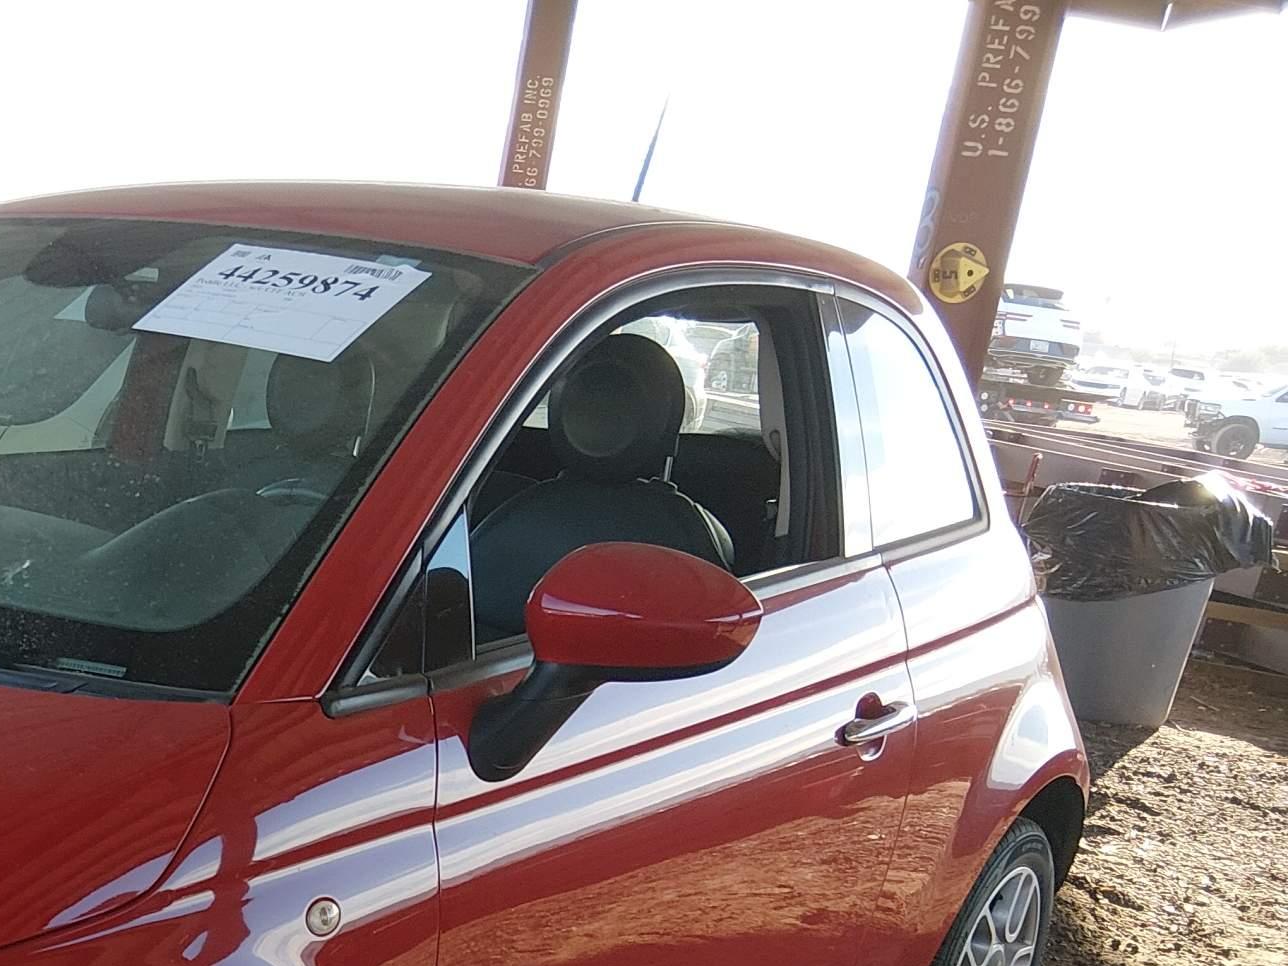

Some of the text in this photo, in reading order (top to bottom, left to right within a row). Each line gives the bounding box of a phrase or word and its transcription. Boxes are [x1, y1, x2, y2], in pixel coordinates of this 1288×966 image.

[512, 75, 541, 173] PREFAB INC.
[960, 105, 993, 157] U.S.
[218, 264, 380, 301] 44259874
